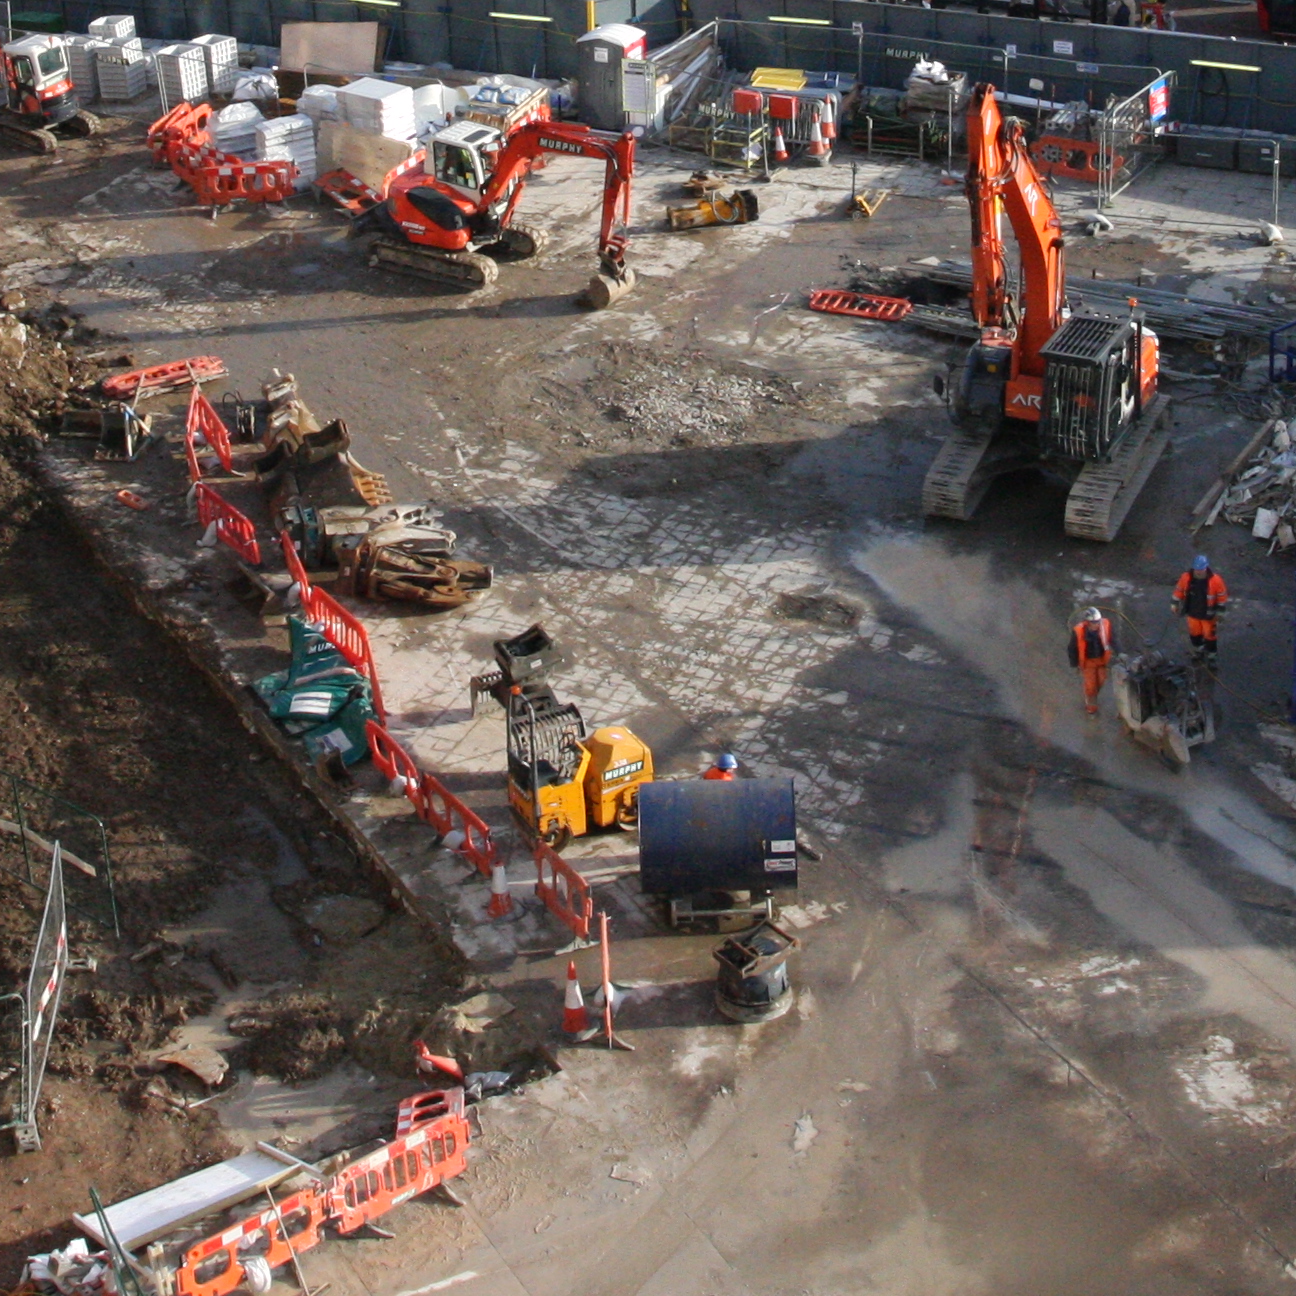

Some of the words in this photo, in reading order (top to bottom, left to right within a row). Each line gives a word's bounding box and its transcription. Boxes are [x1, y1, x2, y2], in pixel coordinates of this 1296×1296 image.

[885, 47, 930, 59] MURPHY
[699, 103, 736, 120] MURPHY
[539, 138, 583, 154] MURPHY
[604, 760, 643, 781] MURPHY
